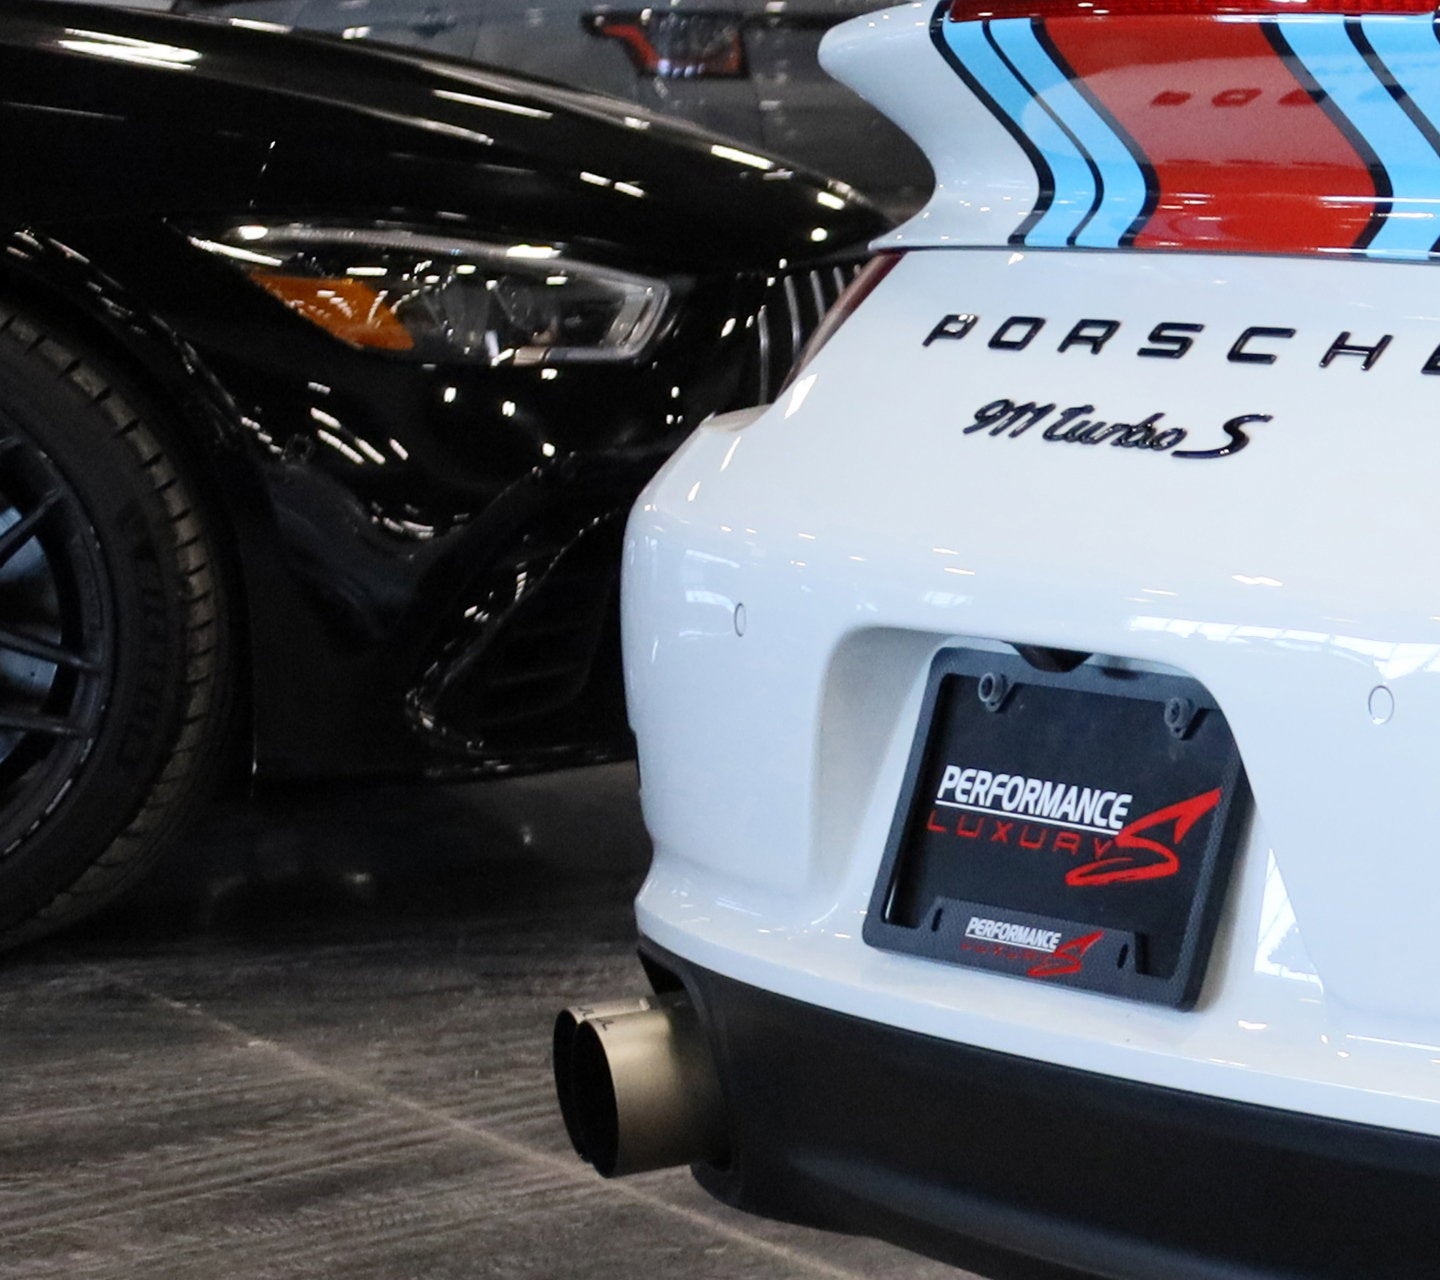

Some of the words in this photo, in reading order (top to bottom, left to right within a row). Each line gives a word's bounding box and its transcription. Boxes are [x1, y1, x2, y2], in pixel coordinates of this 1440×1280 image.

[962, 398, 1057, 439] 911
[1042, 404, 1188, 452] turbo
[1171, 413, 1274, 460] S
[935, 764, 1133, 830] PERFORMANCE
[924, 809, 1116, 859] LUXURY
[966, 916, 1062, 950] PERFORMANCE
